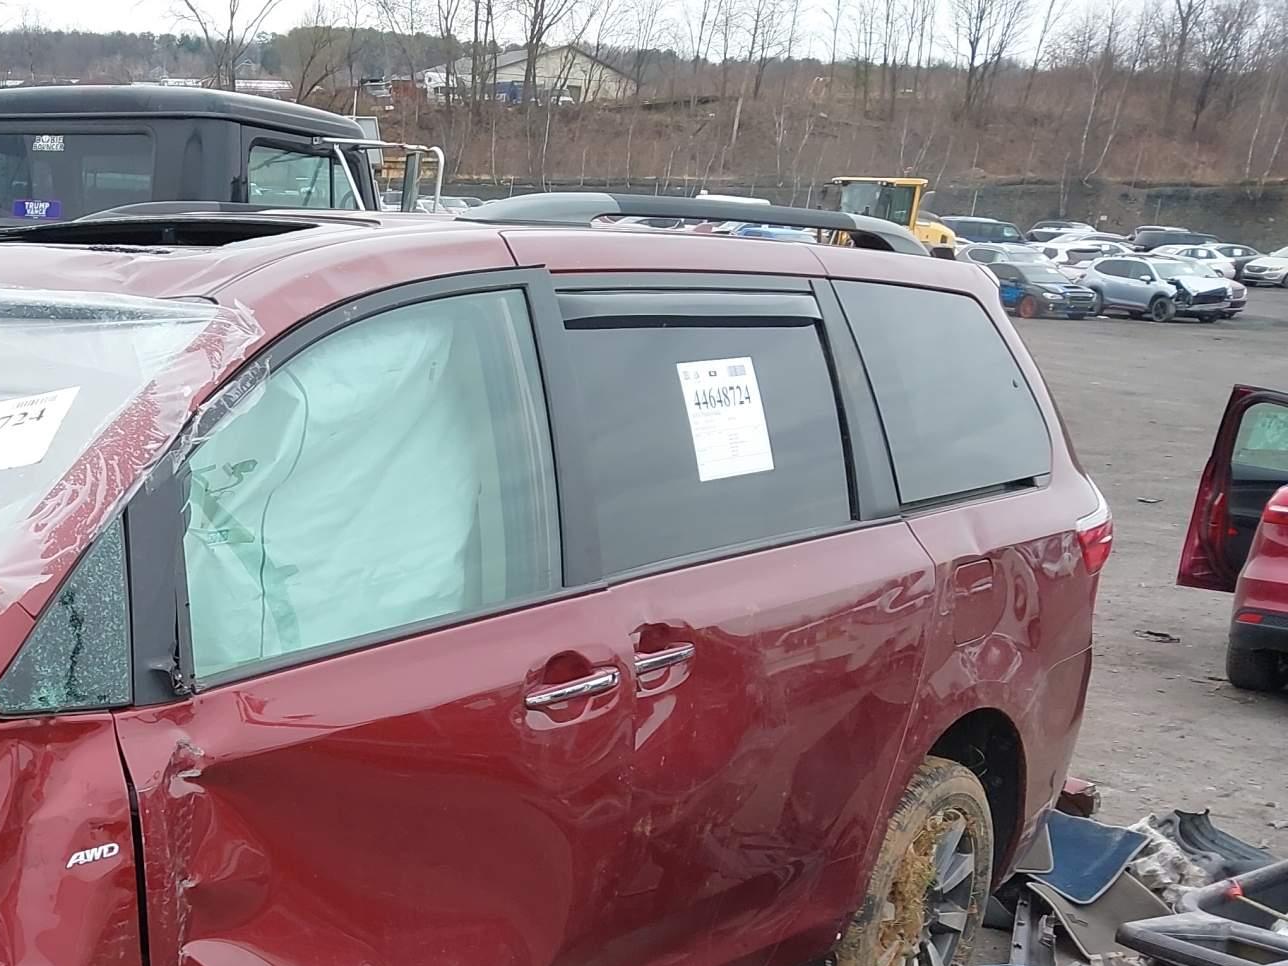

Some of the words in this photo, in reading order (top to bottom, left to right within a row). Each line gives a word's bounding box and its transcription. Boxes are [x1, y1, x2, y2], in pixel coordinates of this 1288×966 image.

[24, 201, 50, 209] TRUMP
[694, 384, 751, 410] 44648724
[66, 843, 120, 869] AWD
